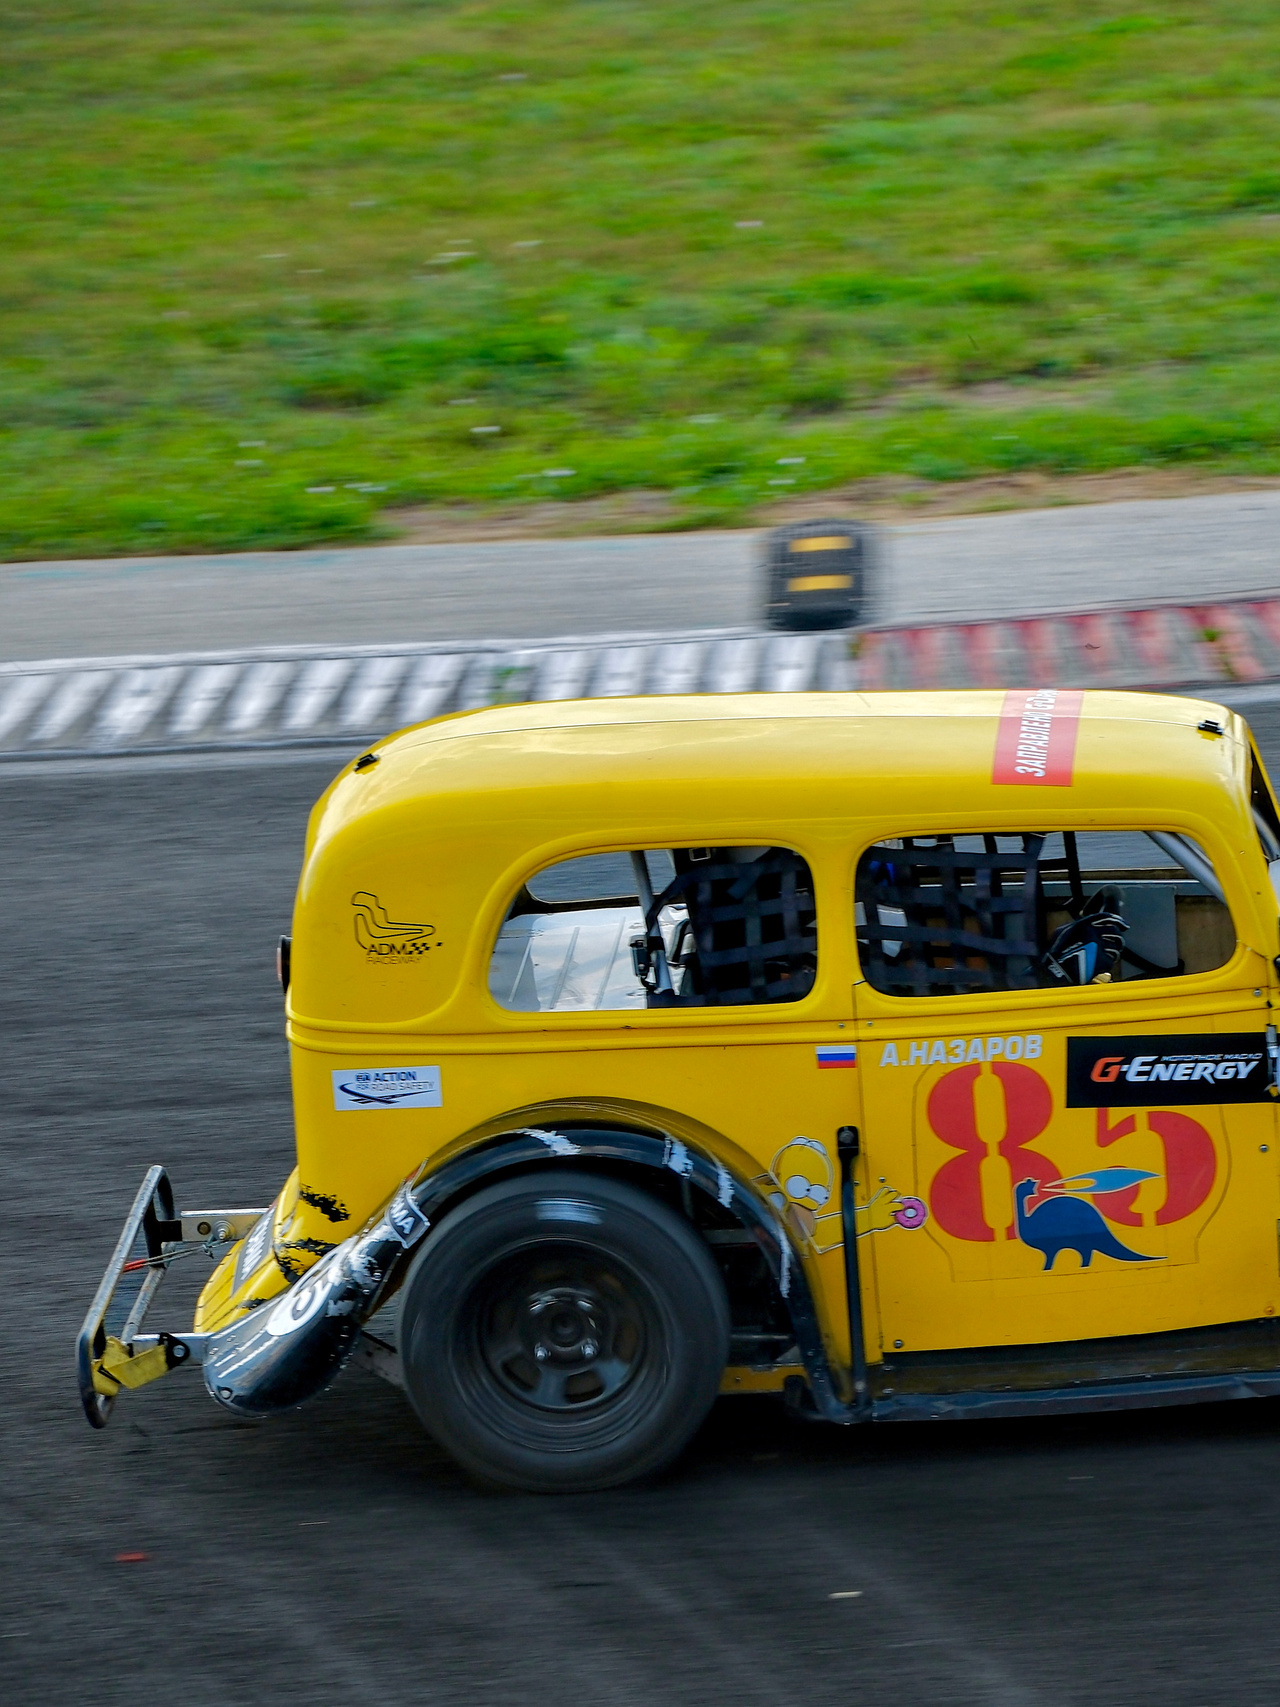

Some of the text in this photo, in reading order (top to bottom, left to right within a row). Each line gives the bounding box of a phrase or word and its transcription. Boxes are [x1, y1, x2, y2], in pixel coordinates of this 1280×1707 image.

[1014, 711, 1053, 777] ЗАПРАВЛЕНО
[366, 943, 408, 956] ADM
[879, 1034, 1043, 1067] А.НАЗАРОВ
[374, 1070, 417, 1082] ACTION
[1090, 1055, 1259, 1084] G-ENERGY
[371, 1082, 397, 1091] ROAD
[399, 1081, 434, 1090] SAFETY
[927, 1061, 1216, 1242] 85
